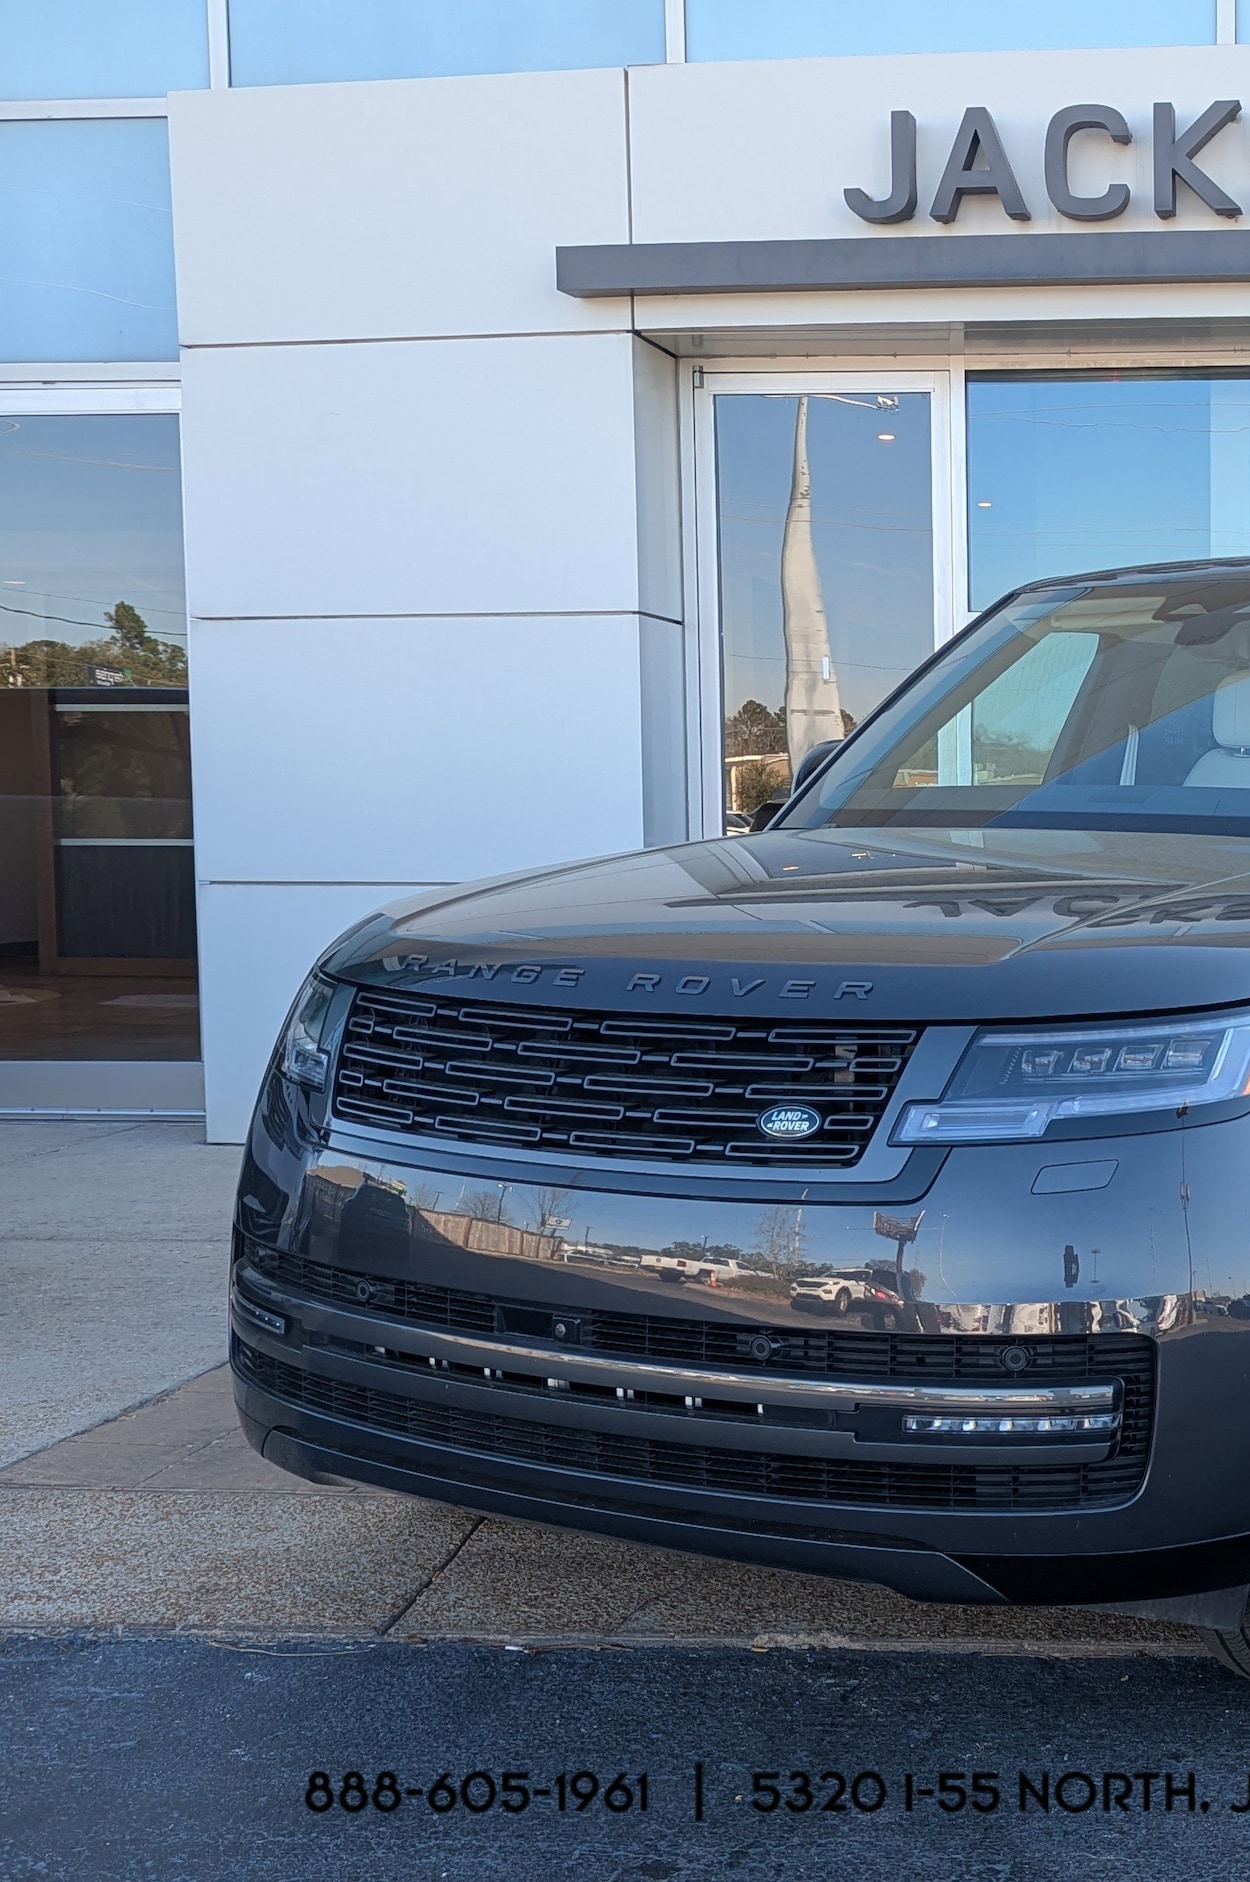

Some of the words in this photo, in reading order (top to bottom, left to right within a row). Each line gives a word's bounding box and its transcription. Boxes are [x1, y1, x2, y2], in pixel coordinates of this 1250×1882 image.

[401, 953, 586, 988] RANGE
[627, 972, 874, 1001] ROVER
[771, 1111, 802, 1121] LAND
[772, 1121, 810, 1131] ROVER
